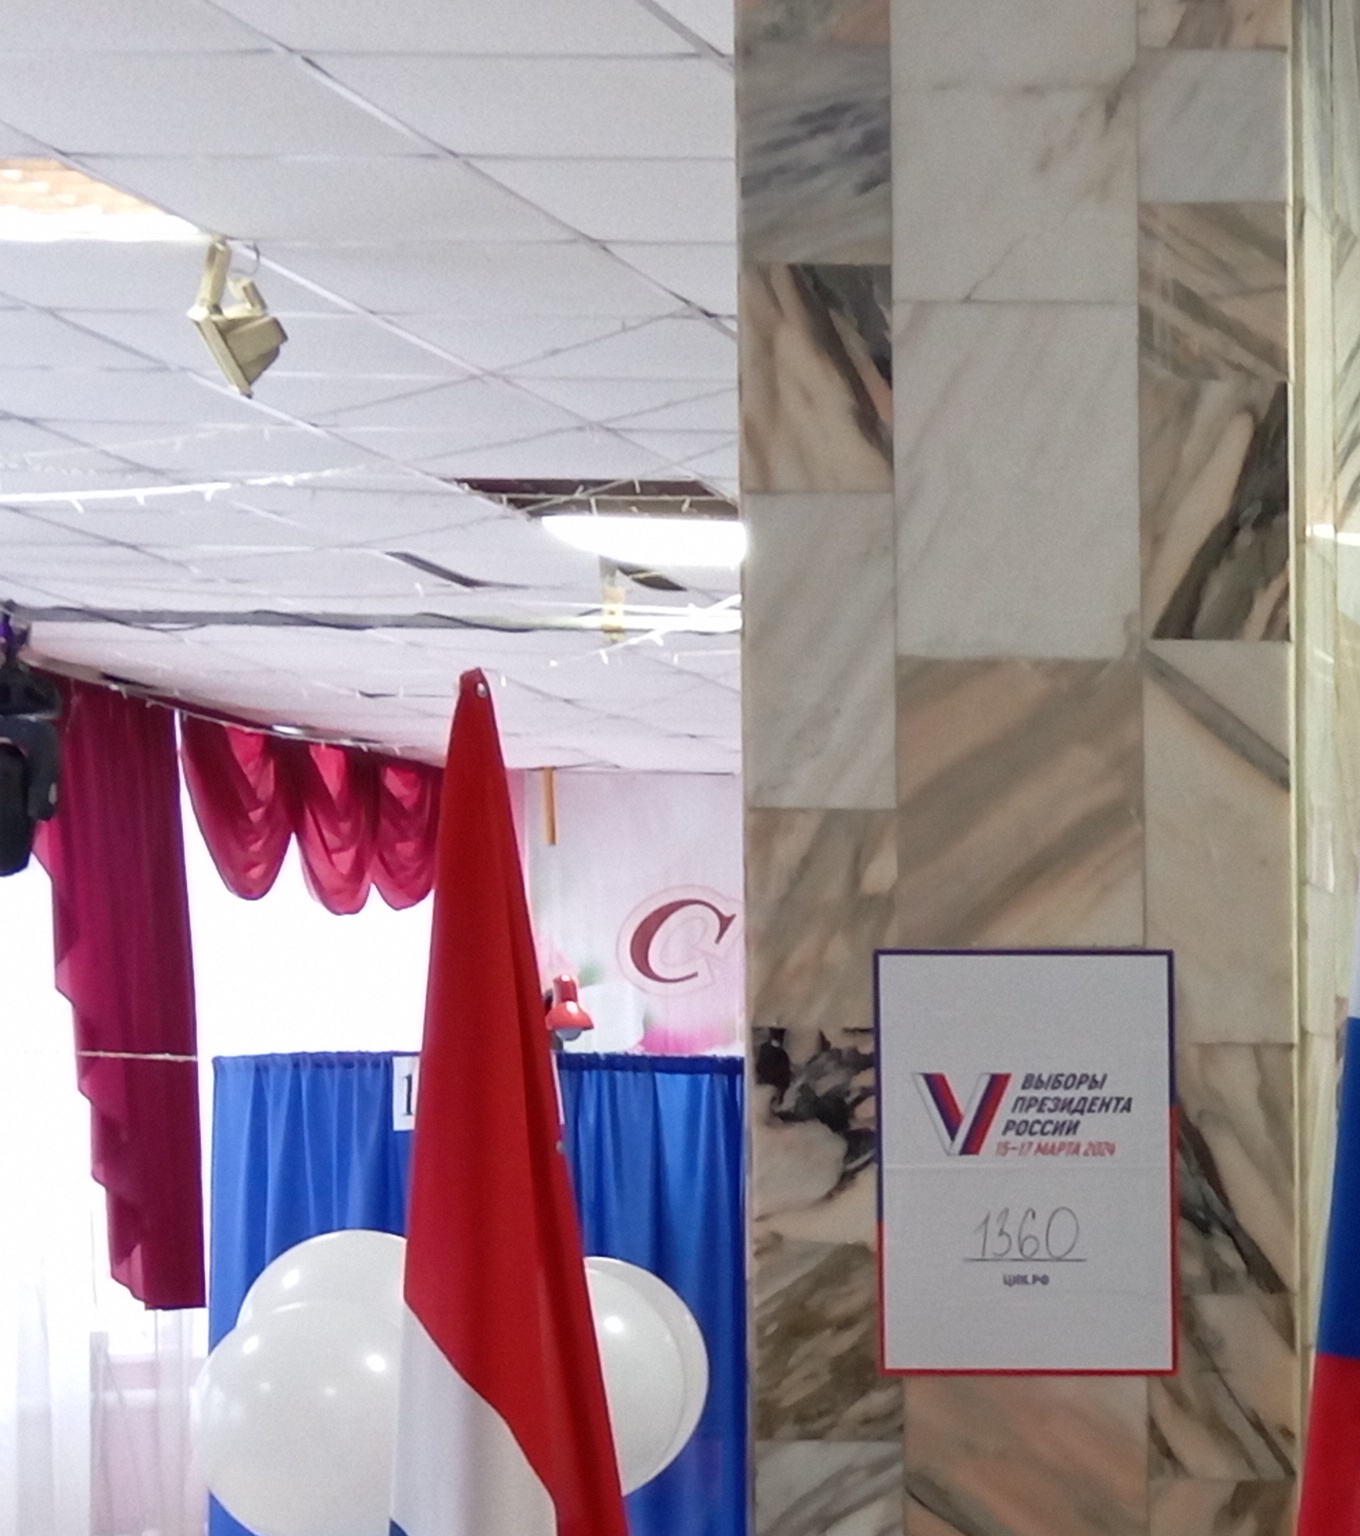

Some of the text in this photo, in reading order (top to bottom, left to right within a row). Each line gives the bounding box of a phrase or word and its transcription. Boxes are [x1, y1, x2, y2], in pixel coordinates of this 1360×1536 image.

[1021, 1073, 1108, 1091] ВЫБОРЫ
[1011, 1096, 1134, 1116] ПРЕЗИДЕНТА
[1001, 1119, 1081, 1137] РОССИИ
[1033, 1141, 1082, 1157] МАРТА
[973, 1206, 1080, 1260] 1360
